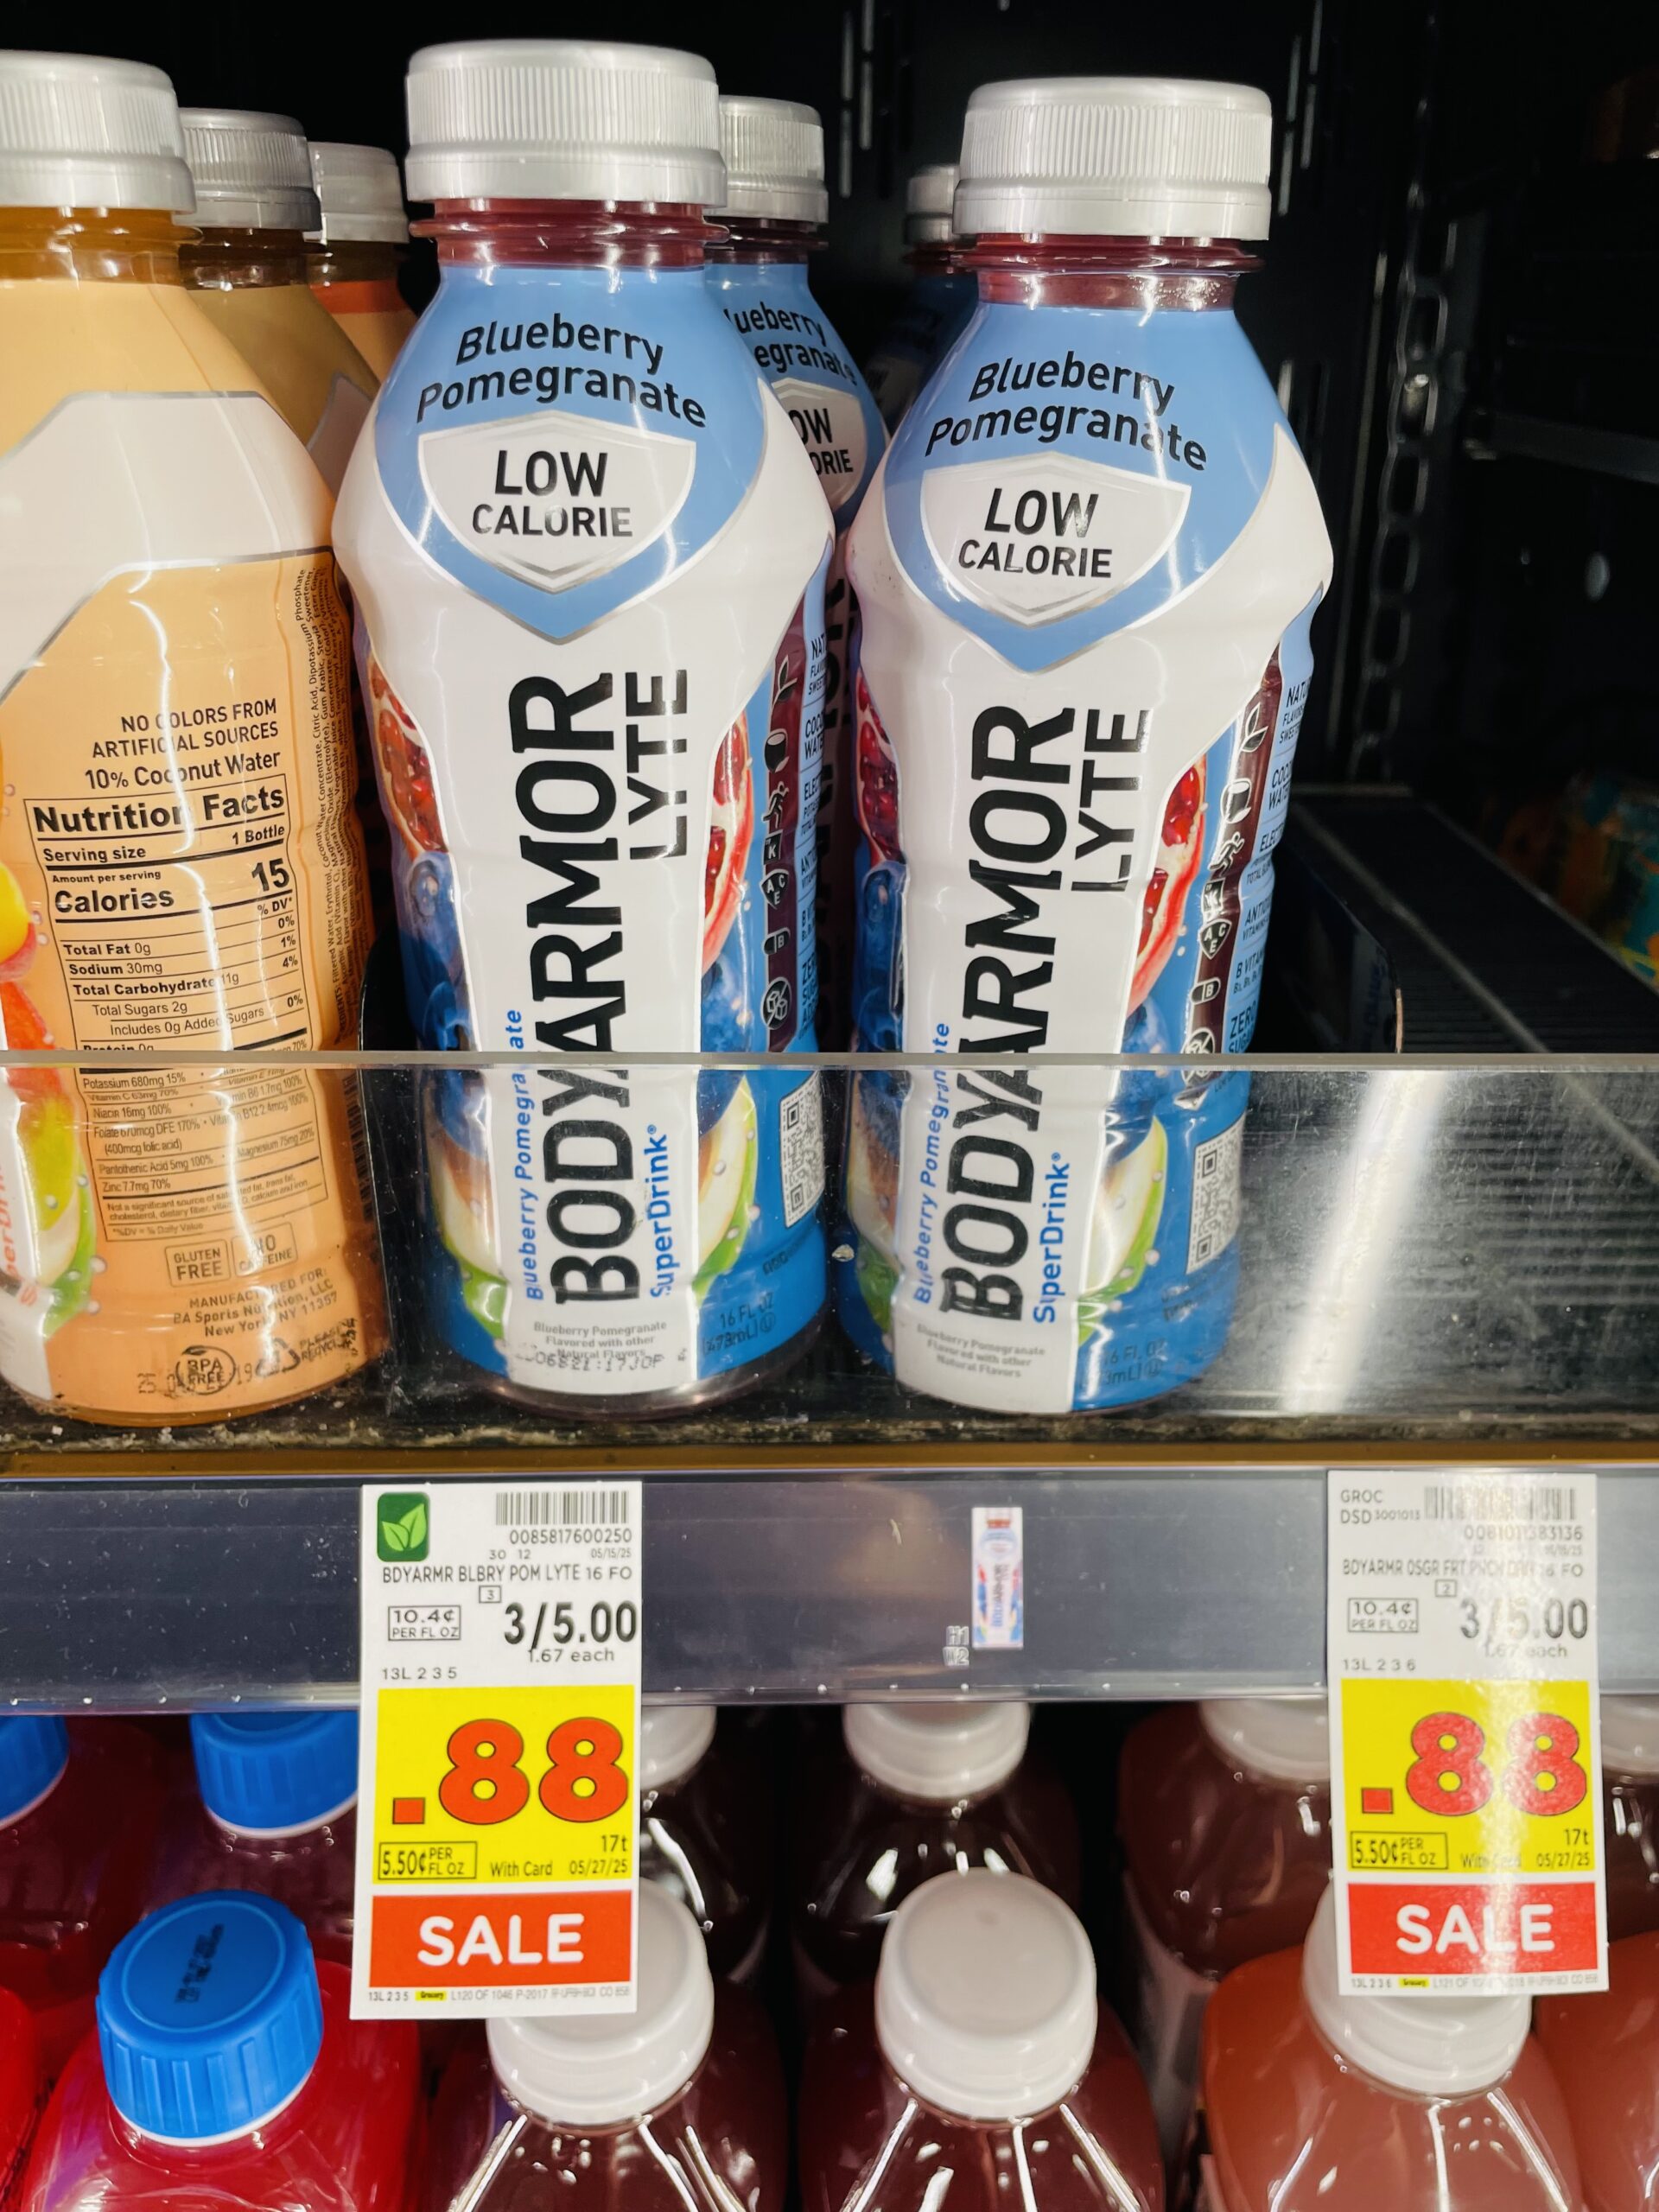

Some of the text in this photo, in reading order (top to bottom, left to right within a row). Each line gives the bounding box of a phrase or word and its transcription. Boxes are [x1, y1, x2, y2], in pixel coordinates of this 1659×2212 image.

[724, 301, 826, 346] ueberry
[455, 313, 663, 375] Blueberry
[753, 343, 858, 386] egranate
[416, 365, 707, 429] Pomegranate
[969, 351, 1174, 416] Blueberry
[788, 408, 833, 445] OW
[925, 405, 1206, 471] Pomegranate
[494, 450, 608, 497] LOW
[809, 448, 854, 475] ORIE
[472, 505, 633, 537] CALORIE
[984, 487, 1099, 538] LOW
[958, 539, 1113, 578] CALORIE
[121, 698, 277, 733] NO COLORS FROM
[204, 721, 279, 748] SOURCES
[85, 751, 281, 790] 10% Coconut Water
[33, 785, 285, 833] Nutrition Facts
[232, 824, 285, 845] 1 Bottle
[43, 846, 147, 862] Serving size
[53, 871, 162, 884] Amount per serving
[54, 857, 290, 913] Calories 15
[63, 915, 296, 956] Total Fat 0g 0%
[69, 934, 296, 976] Sodium 30mg 1%
[73, 984, 111, 995] Total
[114, 977, 216, 995] Carbohydrate
[282, 955, 298, 969] 4%
[509, 672, 640, 1305] BODYARMOR
[625, 670, 688, 861] LYTE
[92, 1001, 188, 1017] Total Sugars 2g
[110, 993, 303, 1036] Includes 0g Added Sugars 0%
[939, 706, 1154, 1321] BODYARMOR LYTE
[83, 1077, 130, 1090] Potassium
[131, 1076, 165, 1089] 680mg
[166, 1072, 187, 1084] 15%
[121, 1107, 146, 1119] 16mg
[147, 1103, 172, 1116] 100%
[156, 1122, 175, 1135] DFE
[505, 1009, 544, 1301] Bueberry Pomegraate
[102, 1178, 171, 1192] Zinc 70%
[173, 1248, 222, 1264] GLUTEN
[175, 1259, 225, 1281] FREE
[189, 1278, 296, 1309] MANUFACTRED
[195, 1279, 334, 1325] Sports LLC
[204, 1324, 235, 1338] New
[533, 1321, 667, 1338] Blueberry Pomegranate
[545, 1336, 594, 1348] Flavored
[1340, 1490, 1383, 1503] GROC
[1340, 1510, 1372, 1524] DSD
[510, 1528, 632, 1545] 0085817600250
[489, 1548, 632, 1560] 30 12 05/15/25
[382, 1564, 632, 1584] BDYARMR BLBRY POM LYTE 16 FO
[486, 1589, 495, 1600] 3
[391, 1626, 460, 1638] PER FL OZ
[393, 1600, 638, 1649] 10.4¢ 3/5.00
[1351, 1618, 1416, 1630] PER FL OZ
[1353, 1599, 1588, 1644] 10.4¢ 3/5.00
[527, 1647, 615, 1662] 1.67 each
[1343, 1659, 1370, 1671] 13L
[1376, 1658, 1386, 1671] 2
[1391, 1658, 1401, 1671] 3
[382, 1667, 458, 1680] 13L 2 3 5
[392, 1716, 629, 1826] .88
[1361, 1712, 1588, 1817] .88
[1401, 1837, 1424, 1850] PER
[382, 1847, 453, 1876] 5.50¢ PER
[428, 1862, 465, 1876] FL OZ
[490, 1859, 628, 1878] With Card 05/27/25
[1400, 1853, 1436, 1865] FL OZ
[1536, 1852, 1591, 1868] 05/27/25
[417, 1912, 585, 1967] SALE
[1396, 1904, 1555, 1955] SALE
